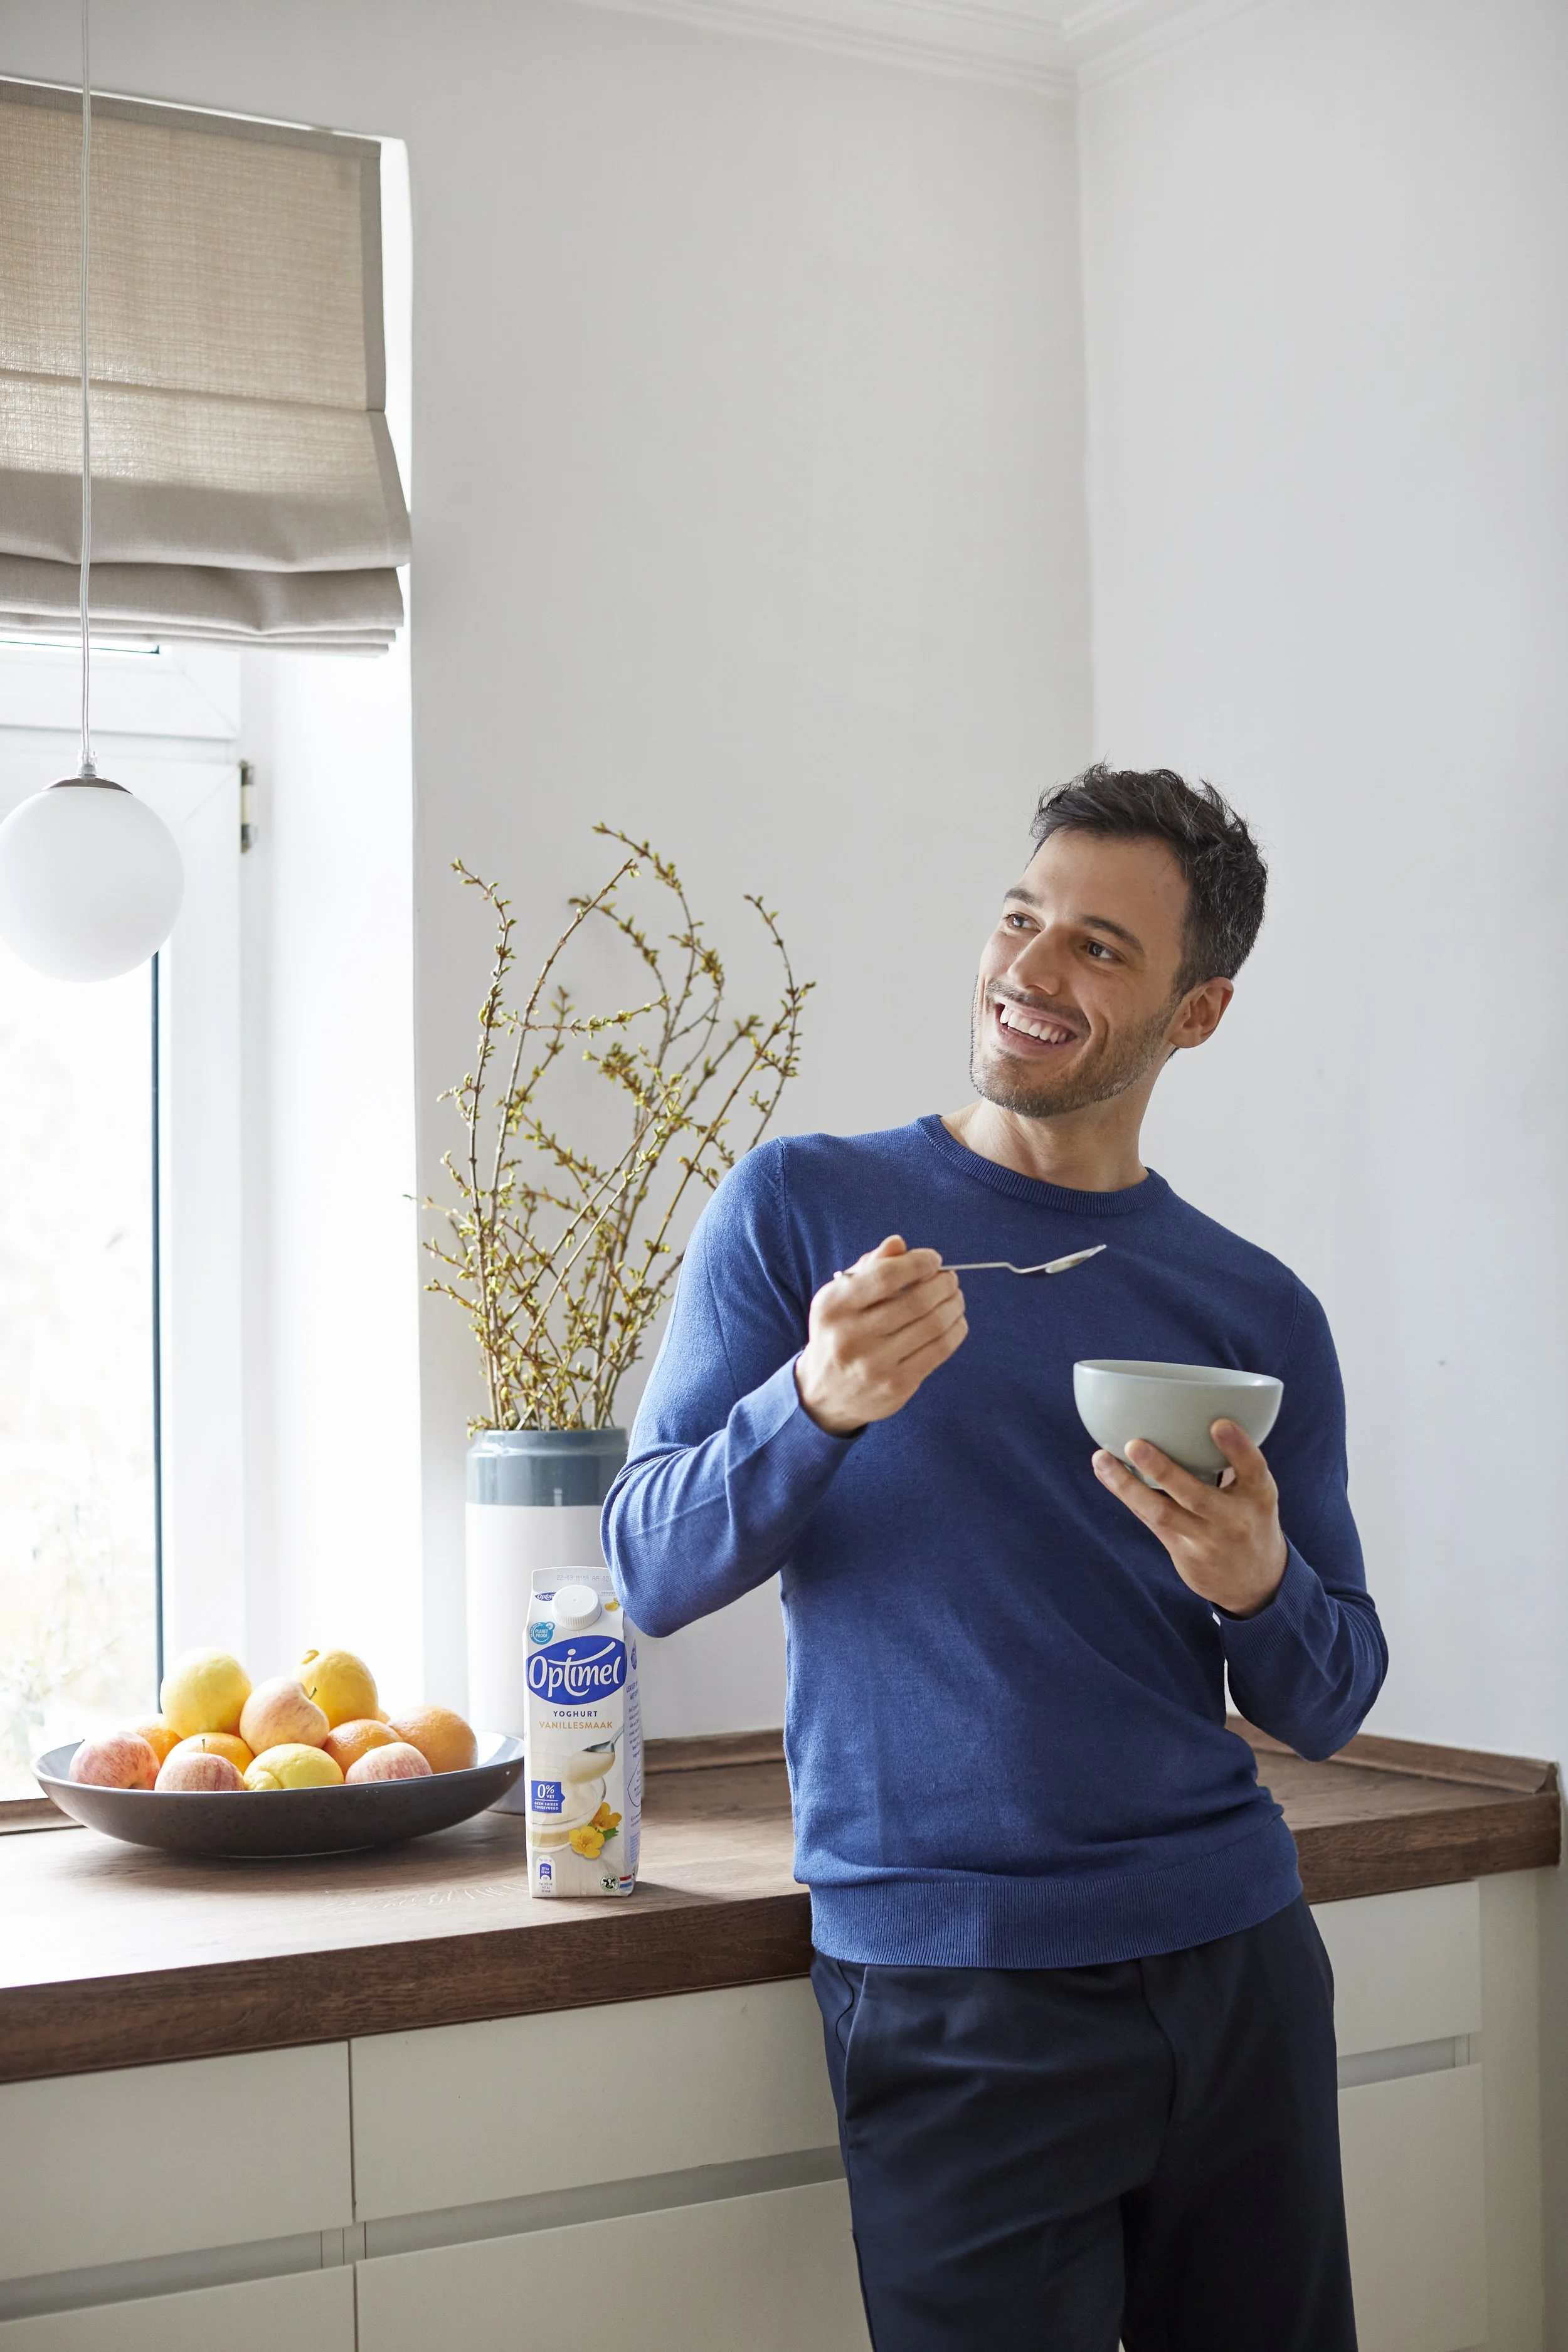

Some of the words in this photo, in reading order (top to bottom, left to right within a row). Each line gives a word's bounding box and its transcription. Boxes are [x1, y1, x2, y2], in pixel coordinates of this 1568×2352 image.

[529, 1641, 621, 1697] Optimel
[539, 1721, 613, 1729] VANILLESMAAK
[537, 1784, 554, 1798] 0%
